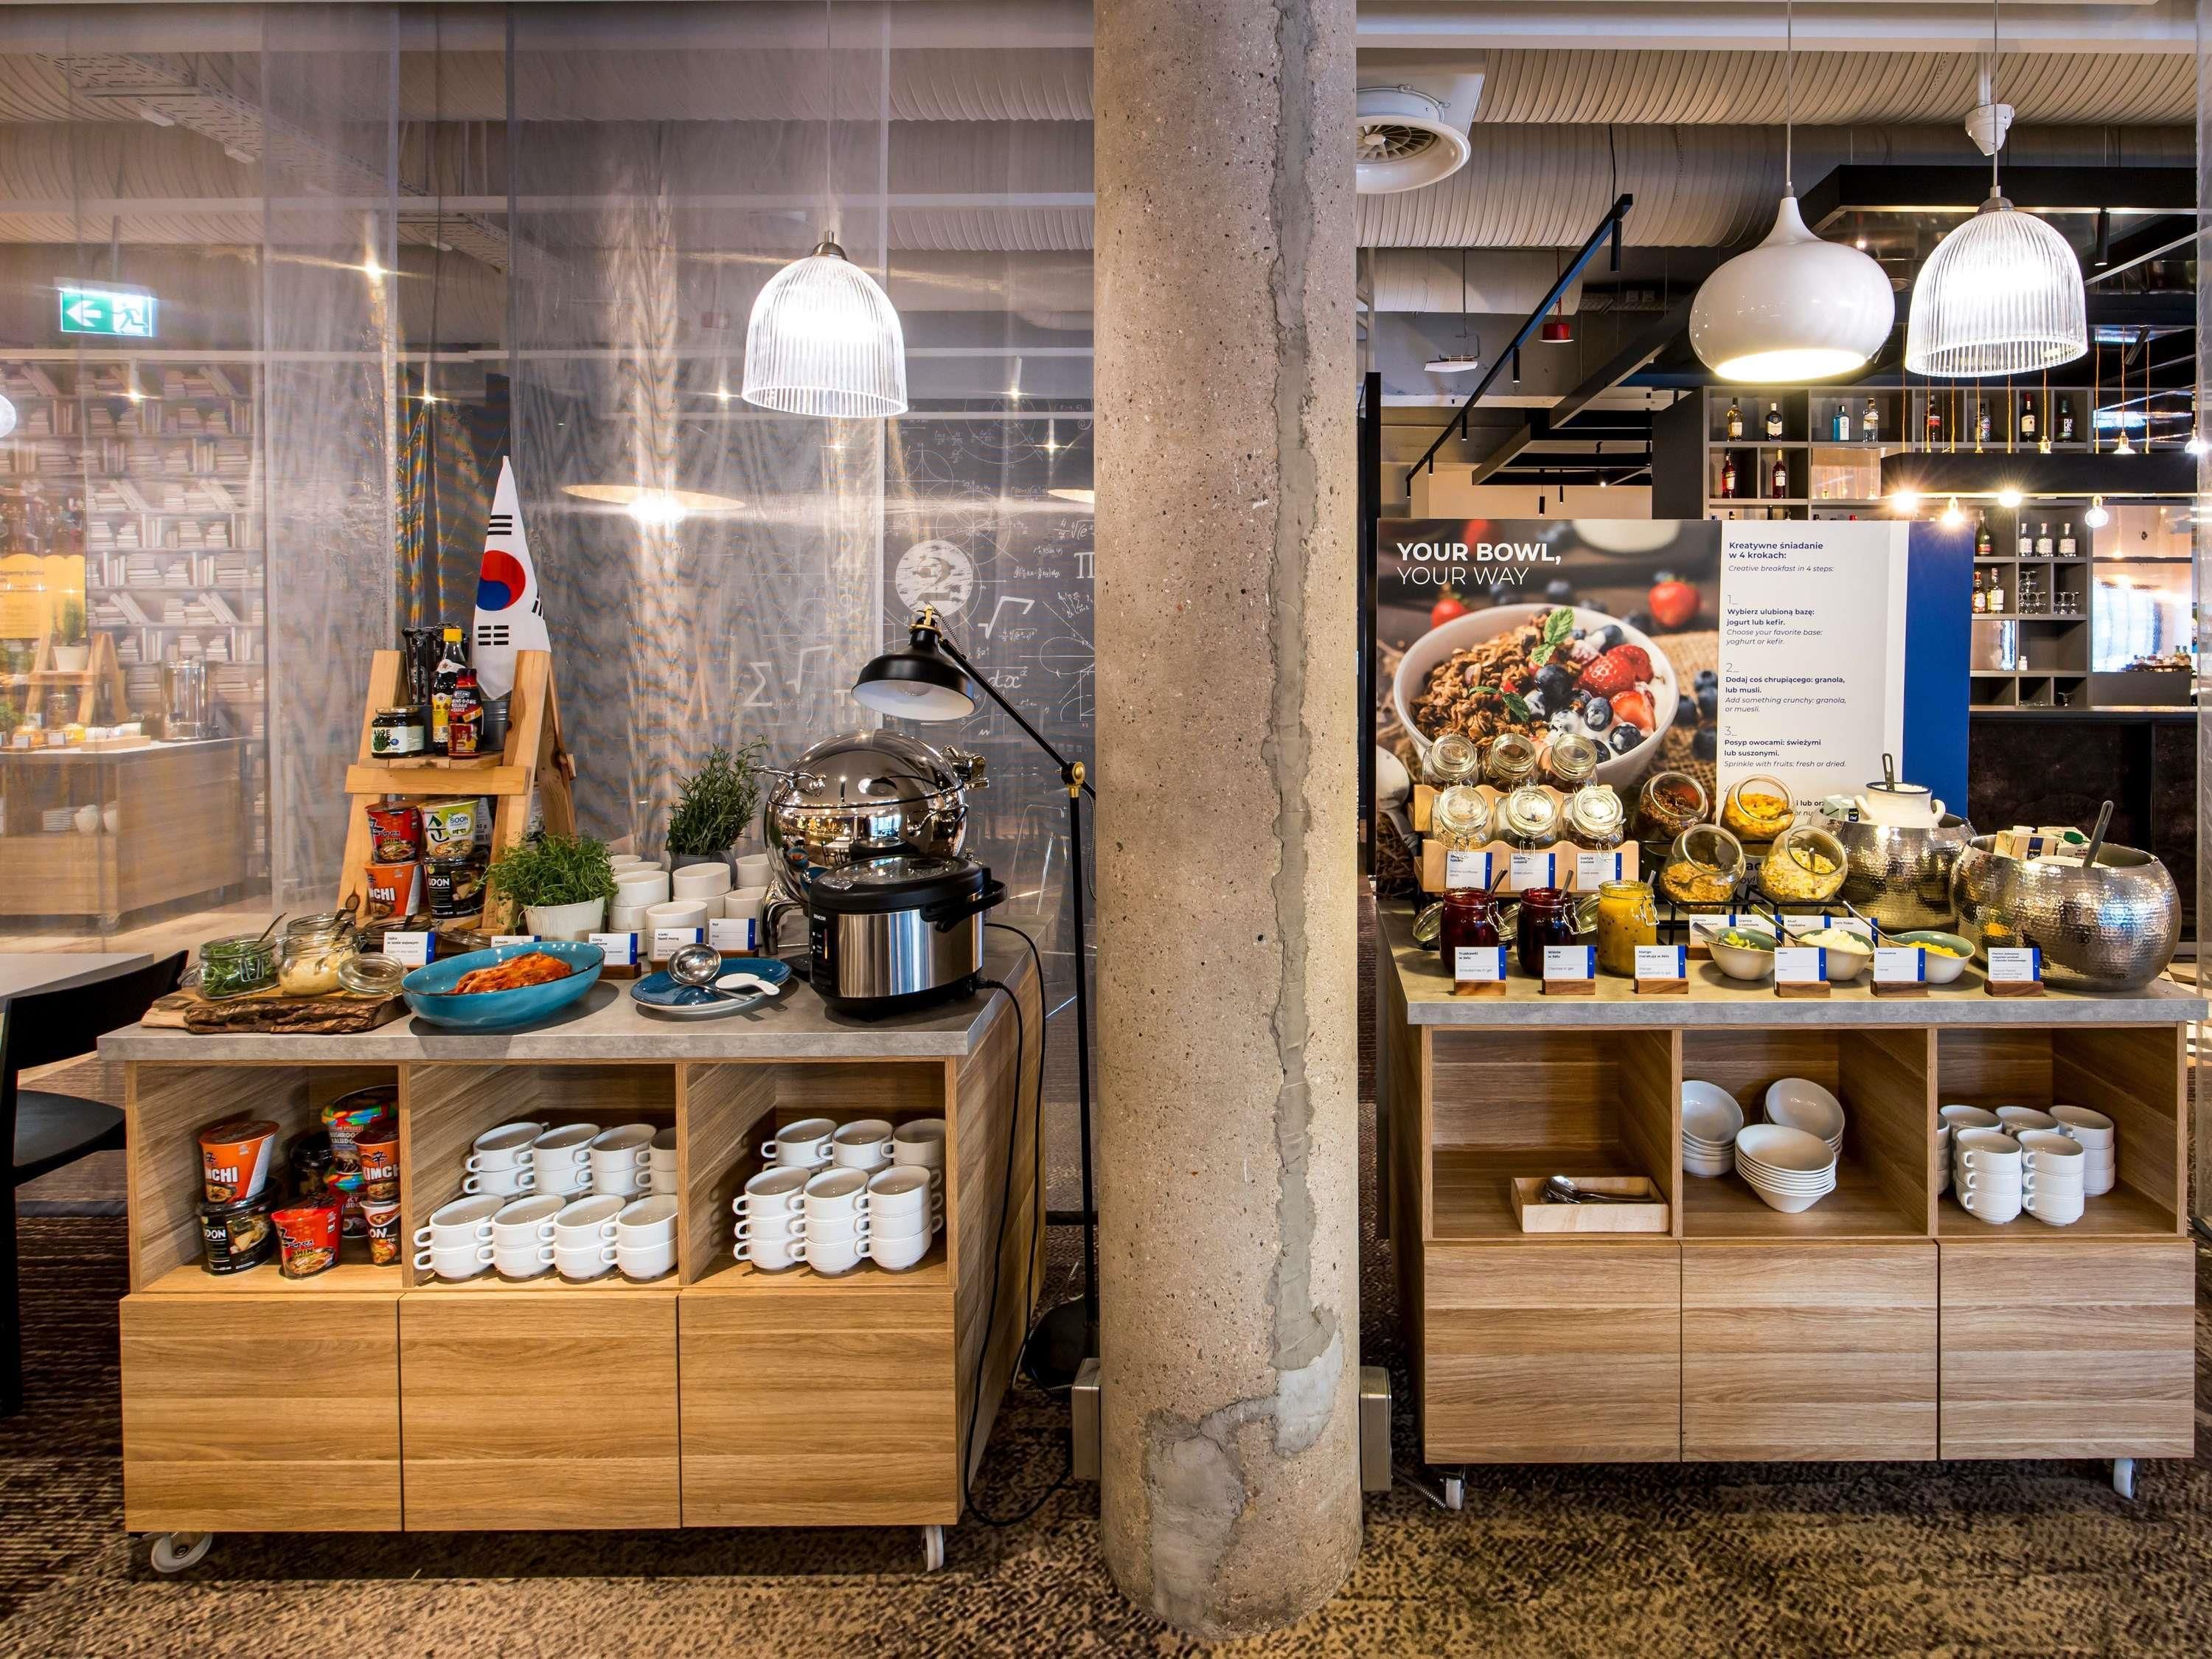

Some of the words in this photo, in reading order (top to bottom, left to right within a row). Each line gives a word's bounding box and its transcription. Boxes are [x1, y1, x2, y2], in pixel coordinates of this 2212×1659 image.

[1729, 541, 1778, 551] Kreatywne
[1780, 540, 1823, 550] śniadanie
[1397, 543, 1469, 561] YOUR
[1476, 543, 1562, 566] BOWL,
[1747, 551, 1787, 559] krokach:
[1397, 566, 1467, 585] YOUR
[1473, 566, 1529, 585] WAY
[1728, 608, 1758, 617] Wybierz
[1760, 608, 1793, 617] ulubioną
[1795, 608, 1815, 617] bazę:
[1727, 619, 1750, 627] jogurt
[1725, 676, 1747, 684] Dodaj
[1764, 676, 1813, 684] chrupiącego:
[1815, 676, 1846, 684] granola,
[1742, 697, 1781, 705] something
[1783, 697, 1814, 706] crunchy:
[1815, 697, 1846, 706] granola,
[1787, 739, 1821, 747] świeżymi
[1738, 750, 1780, 758] suszonymi.
[1724, 760, 1754, 768] Sprinkle
[450, 816, 468, 824] SOON
[428, 877, 451, 887] UDON
